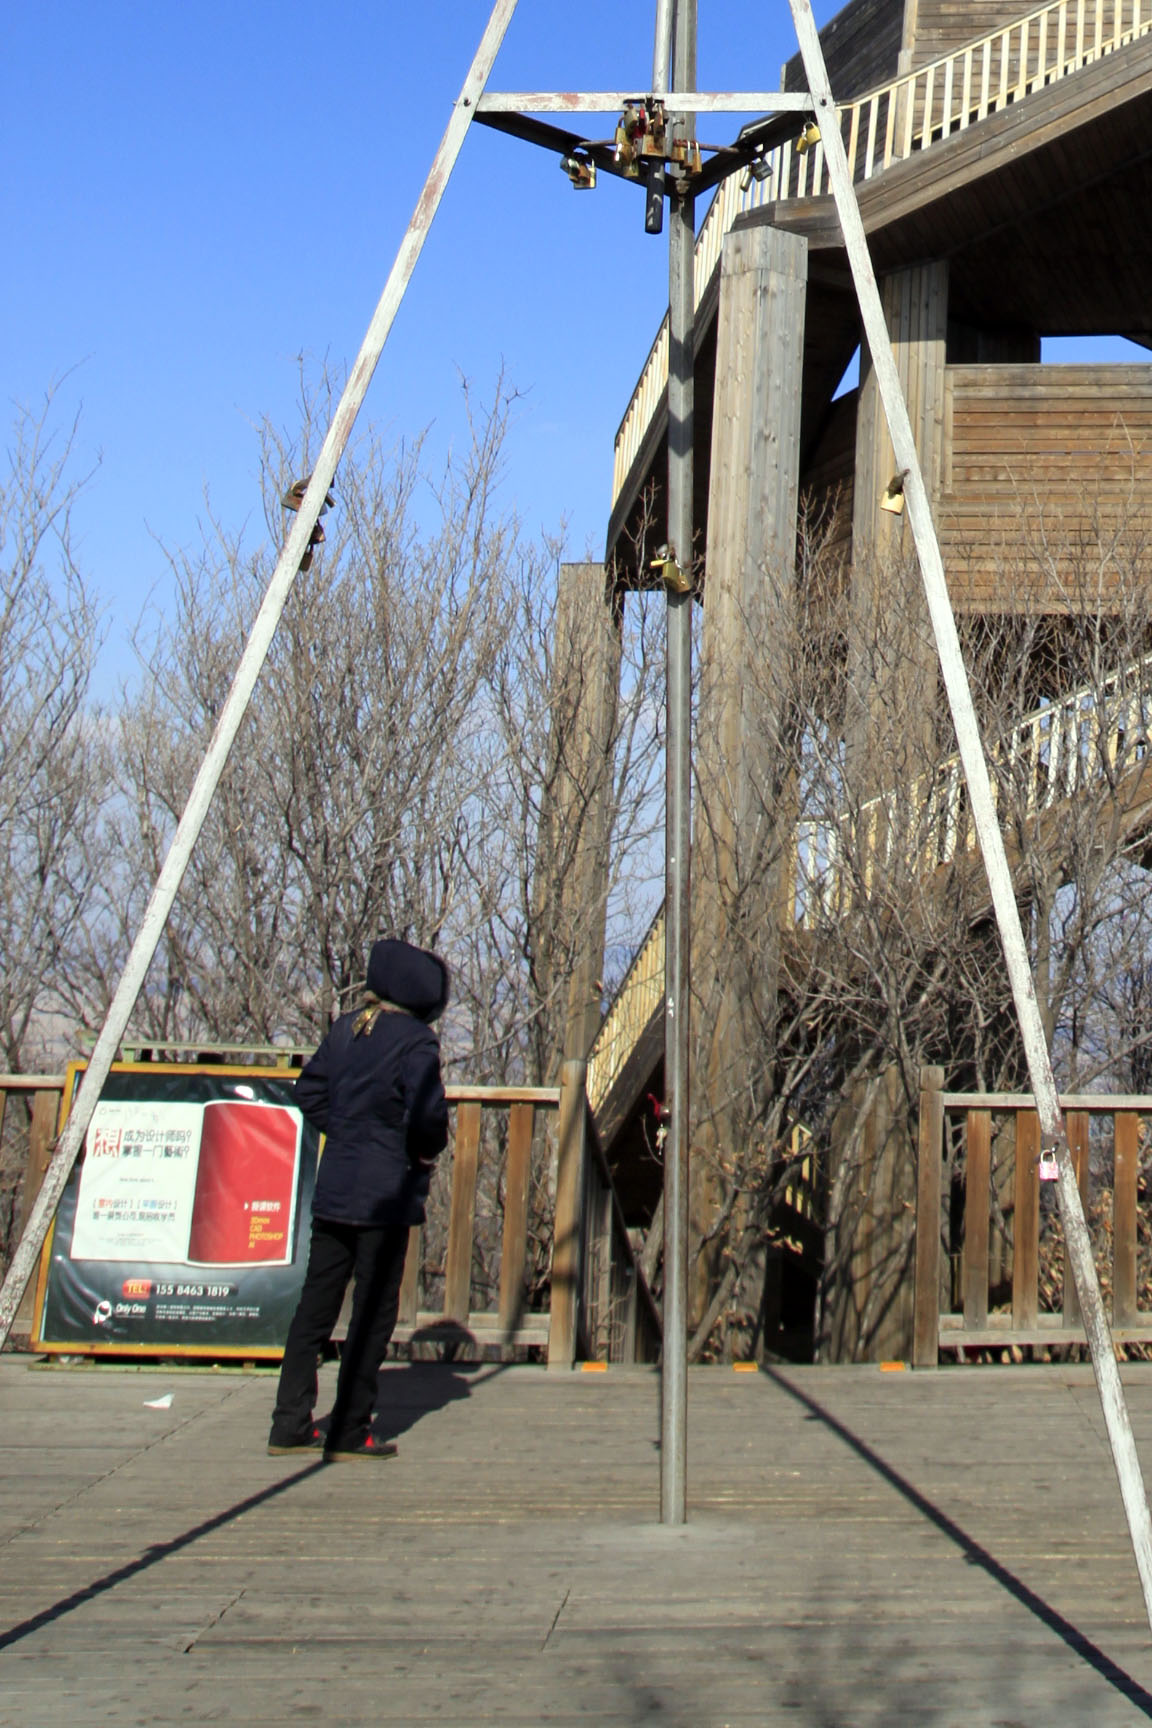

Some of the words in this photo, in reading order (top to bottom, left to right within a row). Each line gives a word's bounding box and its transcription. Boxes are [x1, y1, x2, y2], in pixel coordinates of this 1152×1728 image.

[156, 1284, 173, 1295] 155
[177, 1285, 204, 1296] 8463
[207, 1286, 230, 1297] 1819
[115, 1302, 134, 1314] Only
[133, 1303, 147, 1314] One
